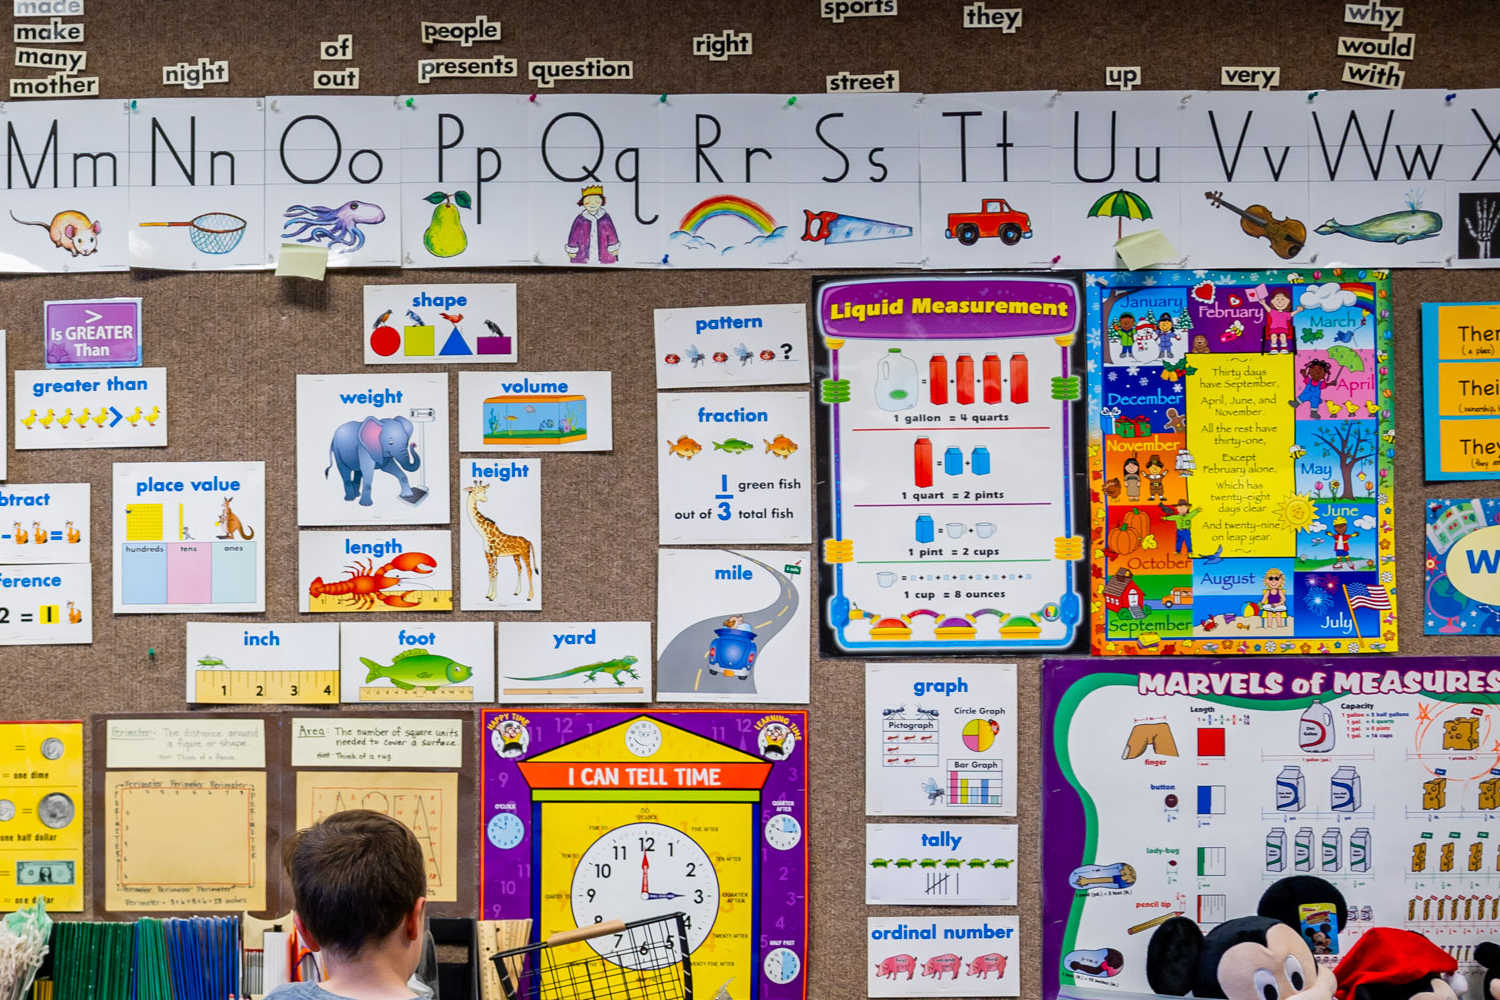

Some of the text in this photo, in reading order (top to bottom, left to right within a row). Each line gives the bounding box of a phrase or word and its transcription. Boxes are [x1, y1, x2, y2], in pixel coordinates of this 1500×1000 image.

[823, 0, 896, 19] sports
[966, 7, 1020, 31] they
[1348, 3, 1401, 28] why
[17, 22, 81, 41] make
[424, 20, 498, 44] people
[325, 38, 349, 58] of
[696, 32, 749, 58] right
[1341, 35, 1411, 57] would
[19, 49, 83, 70] many
[422, 57, 514, 79] presents
[165, 61, 226, 86] night
[317, 68, 356, 87] out
[532, 60, 630, 86] question
[828, 71, 896, 92] street
[1109, 66, 1139, 88] up
[1225, 66, 1278, 90] very
[1346, 63, 1402, 85] with
[13, 76, 96, 95] mother
[412, 292, 468, 311] shape
[830, 297, 1068, 322] Liquid Measurement
[1120, 295, 1183, 312] January
[1198, 303, 1264, 323] February
[1309, 315, 1356, 328] March
[51, 325, 133, 341] Is GREATER
[695, 314, 763, 335] pattern
[73, 342, 109, 357] Than
[32, 376, 148, 397] greater than
[501, 379, 568, 394] volume
[1337, 378, 1375, 398] April
[340, 389, 402, 408] weight
[1107, 393, 1183, 405] December
[698, 408, 768, 424] fraction
[894, 413, 1009, 424] 1 gallon 4 quarts
[1107, 439, 1180, 452] November
[472, 462, 529, 481] height
[1300, 462, 1332, 480] May
[136, 477, 241, 496] place value
[738, 479, 802, 492] green fish
[675, 508, 794, 519] out of total fish
[1322, 504, 1358, 518] June
[124, 544, 165, 555] hundreds
[180, 545, 197, 553] tens
[345, 538, 402, 557] length
[1128, 557, 1191, 569] October
[714, 566, 753, 581] mile
[1200, 572, 1256, 590] August
[1109, 619, 1192, 636] September
[1320, 616, 1353, 634] July
[243, 631, 280, 647] inch
[398, 631, 436, 647] foot
[553, 630, 597, 649] yard
[914, 678, 968, 697] graph
[1138, 671, 1284, 696] MARVELS
[1289, 671, 1324, 695] of
[954, 707, 1006, 717] Circle Graph
[1340, 703, 1374, 711] Capacity
[334, 727, 352, 736] The
[357, 727, 388, 736] number
[392, 727, 402, 737] of
[405, 729, 432, 739] square
[436, 729, 459, 737] units
[889, 721, 933, 731] Pictograph
[954, 761, 998, 770] Bar Graph
[568, 768, 721, 786] I CAN TELL TIME
[921, 832, 962, 851] tally
[871, 924, 1013, 942] ordinal number
